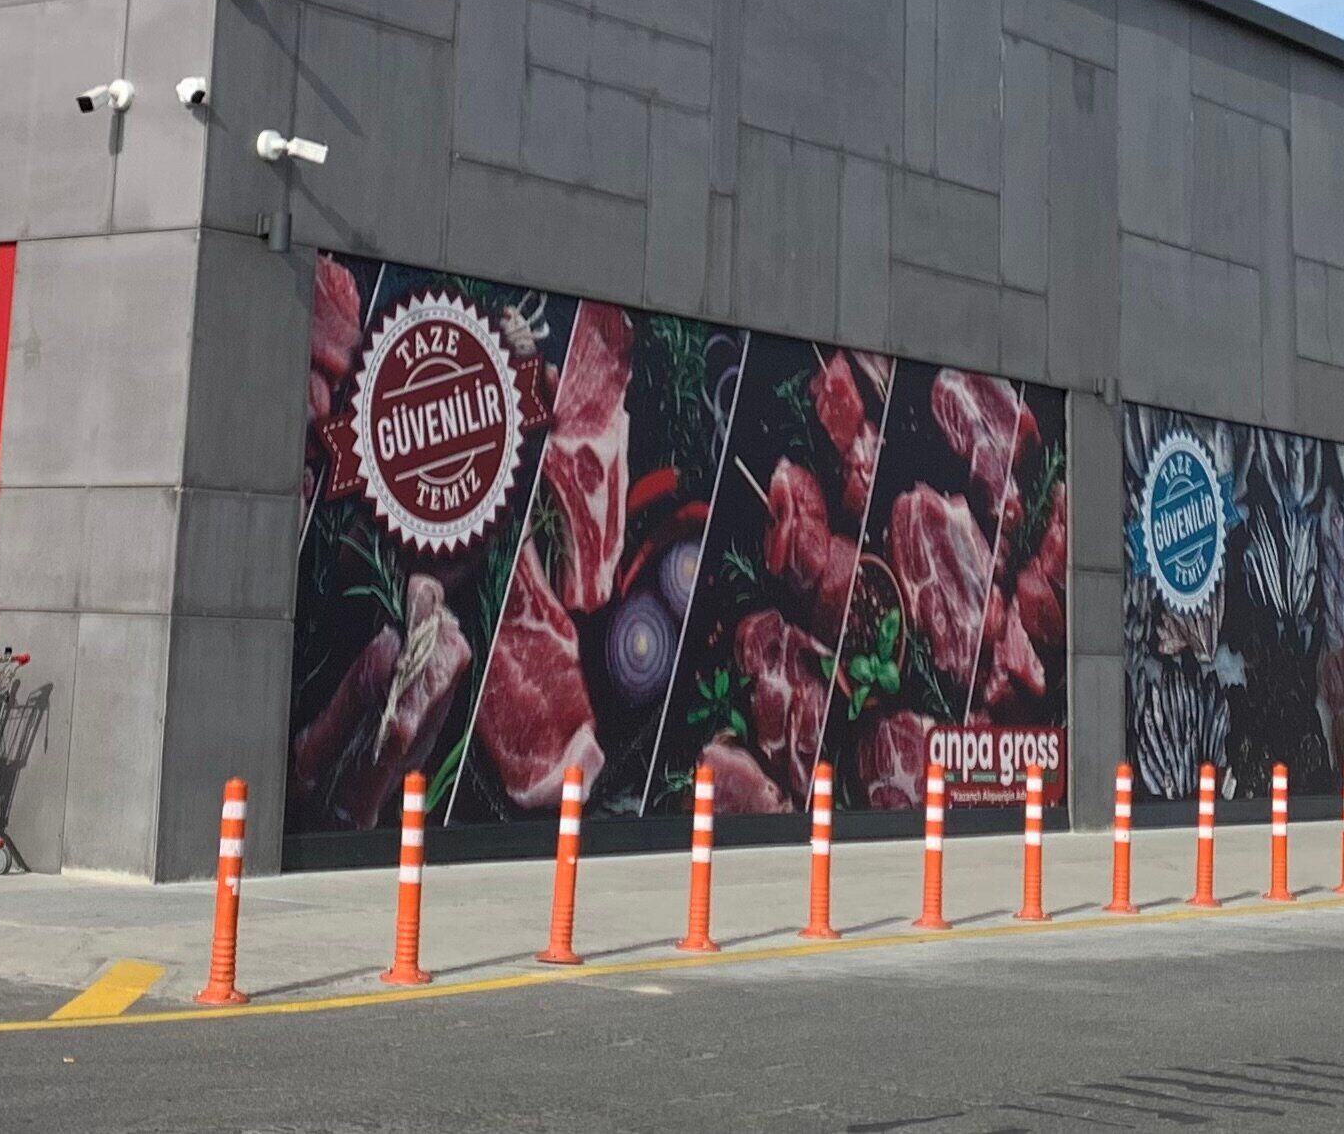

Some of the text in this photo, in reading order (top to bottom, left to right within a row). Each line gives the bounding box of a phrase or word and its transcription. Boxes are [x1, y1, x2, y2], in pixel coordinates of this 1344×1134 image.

[395, 326, 460, 368] TAZE
[376, 378, 502, 462] GÜVENİLİR
[415, 467, 482, 512] TEMİZ
[1160, 453, 1193, 486] TAZE
[1154, 492, 1216, 552] GÜVENİLİR
[930, 730, 1059, 786] anpa gross
